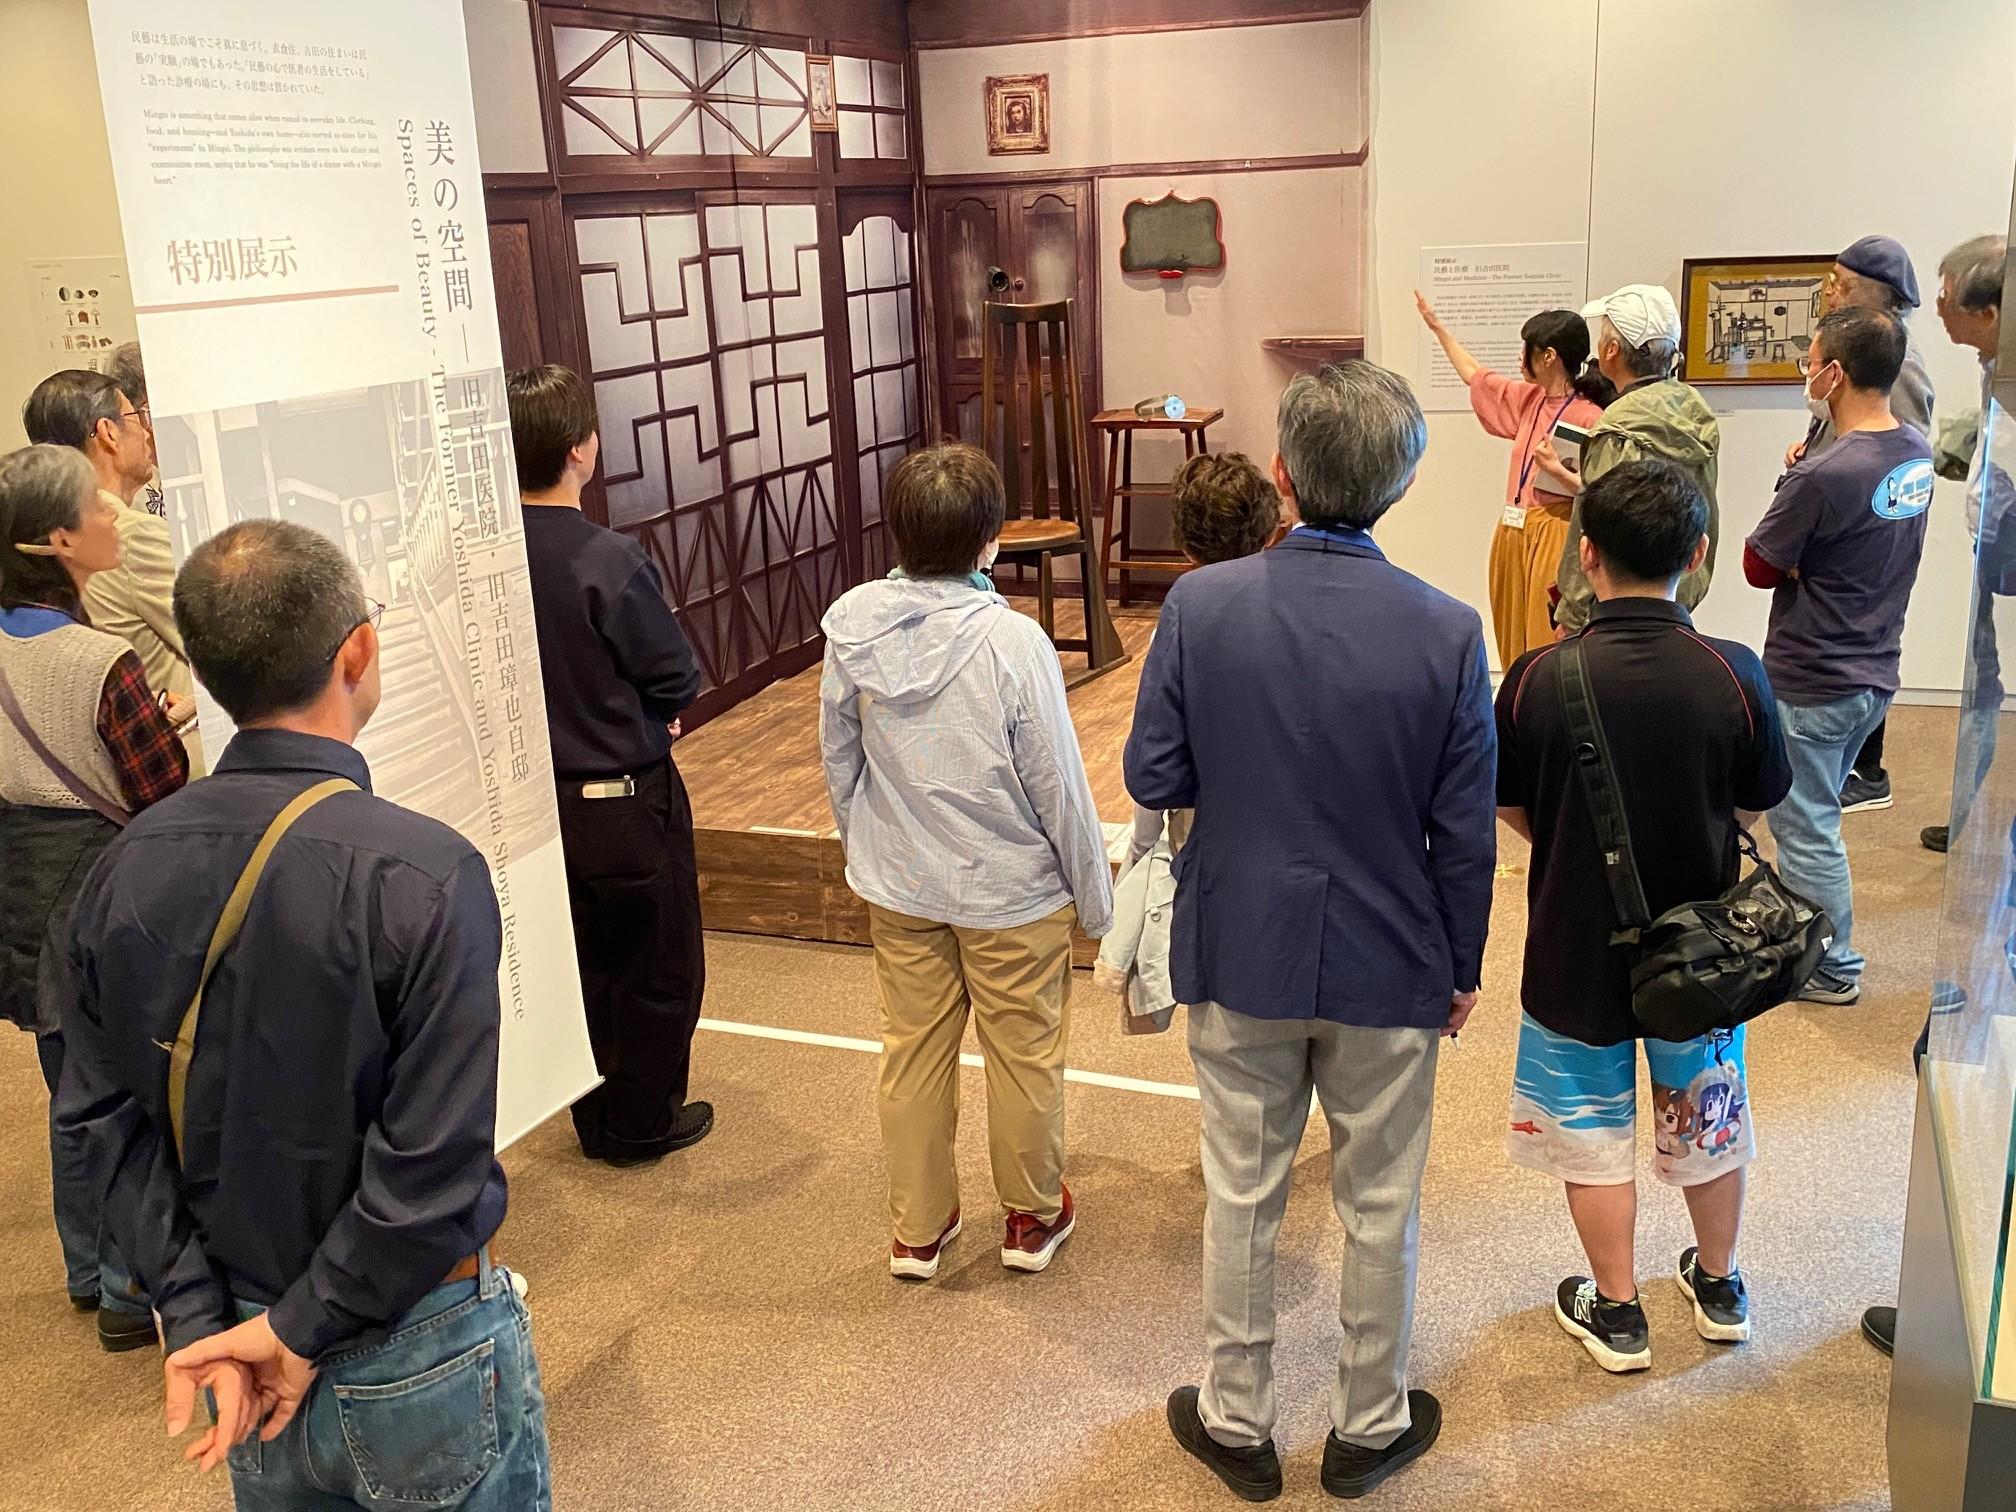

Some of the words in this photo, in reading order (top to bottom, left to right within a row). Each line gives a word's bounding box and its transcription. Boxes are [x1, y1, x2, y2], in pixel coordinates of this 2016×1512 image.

[397, 118, 420, 208] Spaces
[167, 236, 298, 286] 特別展示
[411, 218, 428, 244] of
[416, 251, 438, 339] Beauty
[431, 364, 448, 414] The
[439, 424, 460, 512] Former
[452, 519, 474, 614] Yoshida
[465, 621, 486, 691] Clinic
[474, 700, 493, 741] and
[481, 747, 504, 836] Yoshida
[494, 842, 512, 908] Shoya
[504, 912, 524, 1022] Residence
